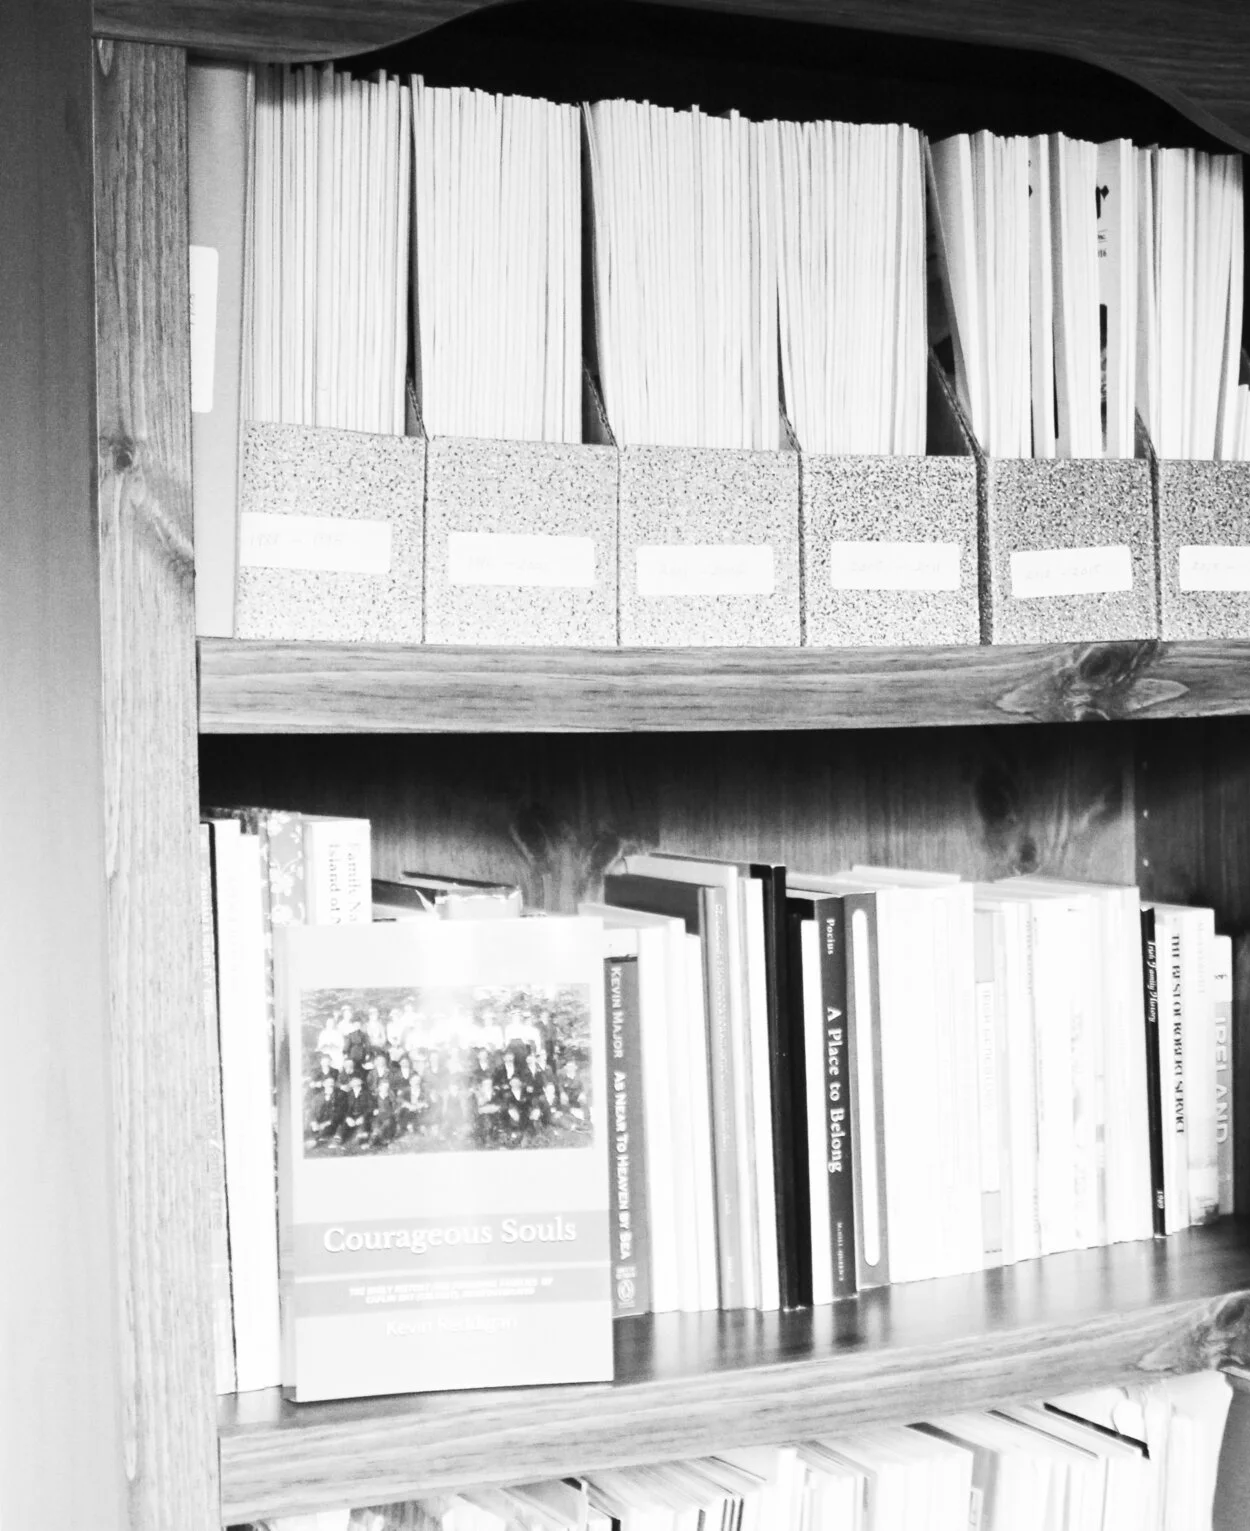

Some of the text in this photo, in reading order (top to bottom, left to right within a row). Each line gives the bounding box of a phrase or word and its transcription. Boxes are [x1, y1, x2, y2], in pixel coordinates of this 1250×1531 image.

[348, 901, 362, 923] Na
[826, 918, 836, 956] Pocius
[1171, 934, 1181, 958] THE
[1171, 964, 1181, 998] BEST
[610, 966, 625, 1059] KEVIN MAJOR
[1173, 1022, 1183, 1076] ROBERT
[827, 1007, 845, 1174] A Place to Belong
[1174, 1080, 1185, 1136] SERVICE
[614, 1093, 628, 1133] NEAR
[615, 1134, 629, 1154] TO
[616, 1155, 630, 1211] HEAVEN
[323, 1214, 577, 1254] Courageous Souls
[618, 1211, 631, 1230] BY
[619, 1230, 632, 1261] SEA
[386, 1317, 432, 1337] Kevin
